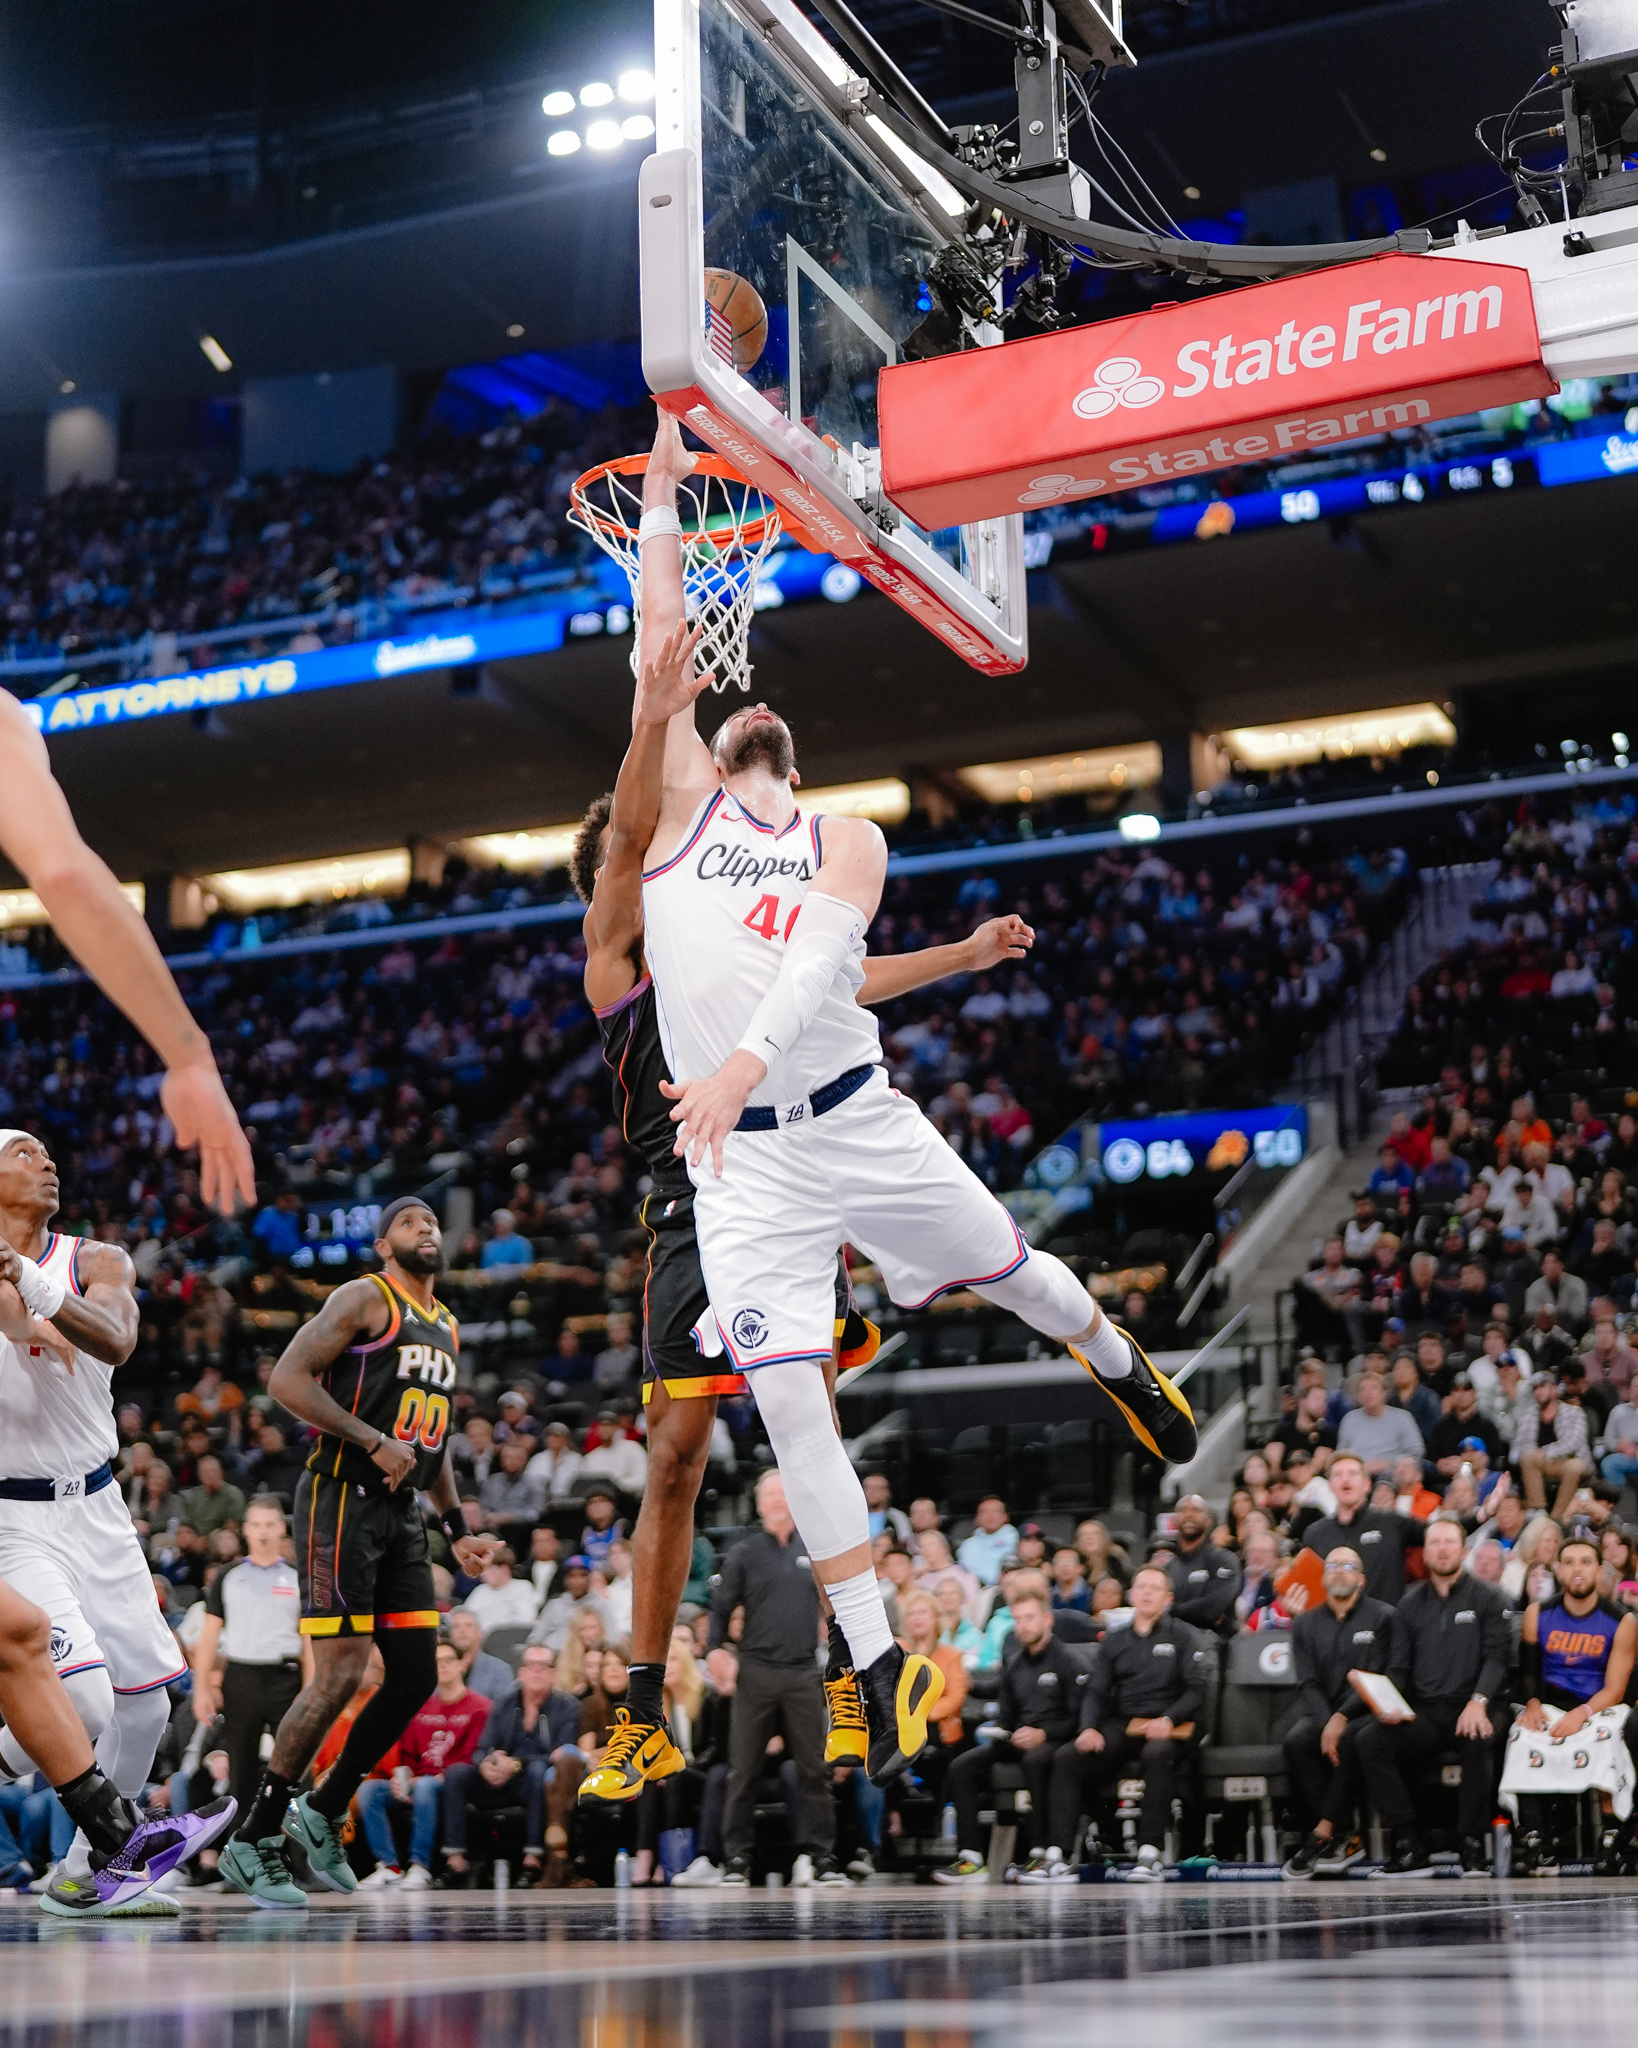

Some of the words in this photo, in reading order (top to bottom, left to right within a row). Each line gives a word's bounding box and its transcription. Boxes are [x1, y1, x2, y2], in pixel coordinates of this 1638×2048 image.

[687, 407, 730, 440] HERDEZ
[722, 439, 760, 467] SALSA
[780, 487, 819, 516] HERDEZ
[812, 514, 845, 543] SALSA
[1281, 490, 1321, 523] 50
[863, 563, 898, 585] HERDEZ
[891, 583, 923, 605] SALSA
[936, 622, 968, 646] HERDEZ
[962, 644, 991, 665] SALSA
[49, 659, 298, 730] ATTORNEYS
[1253, 1128, 1302, 1169] 50
[393, 1387, 450, 1454] 00
